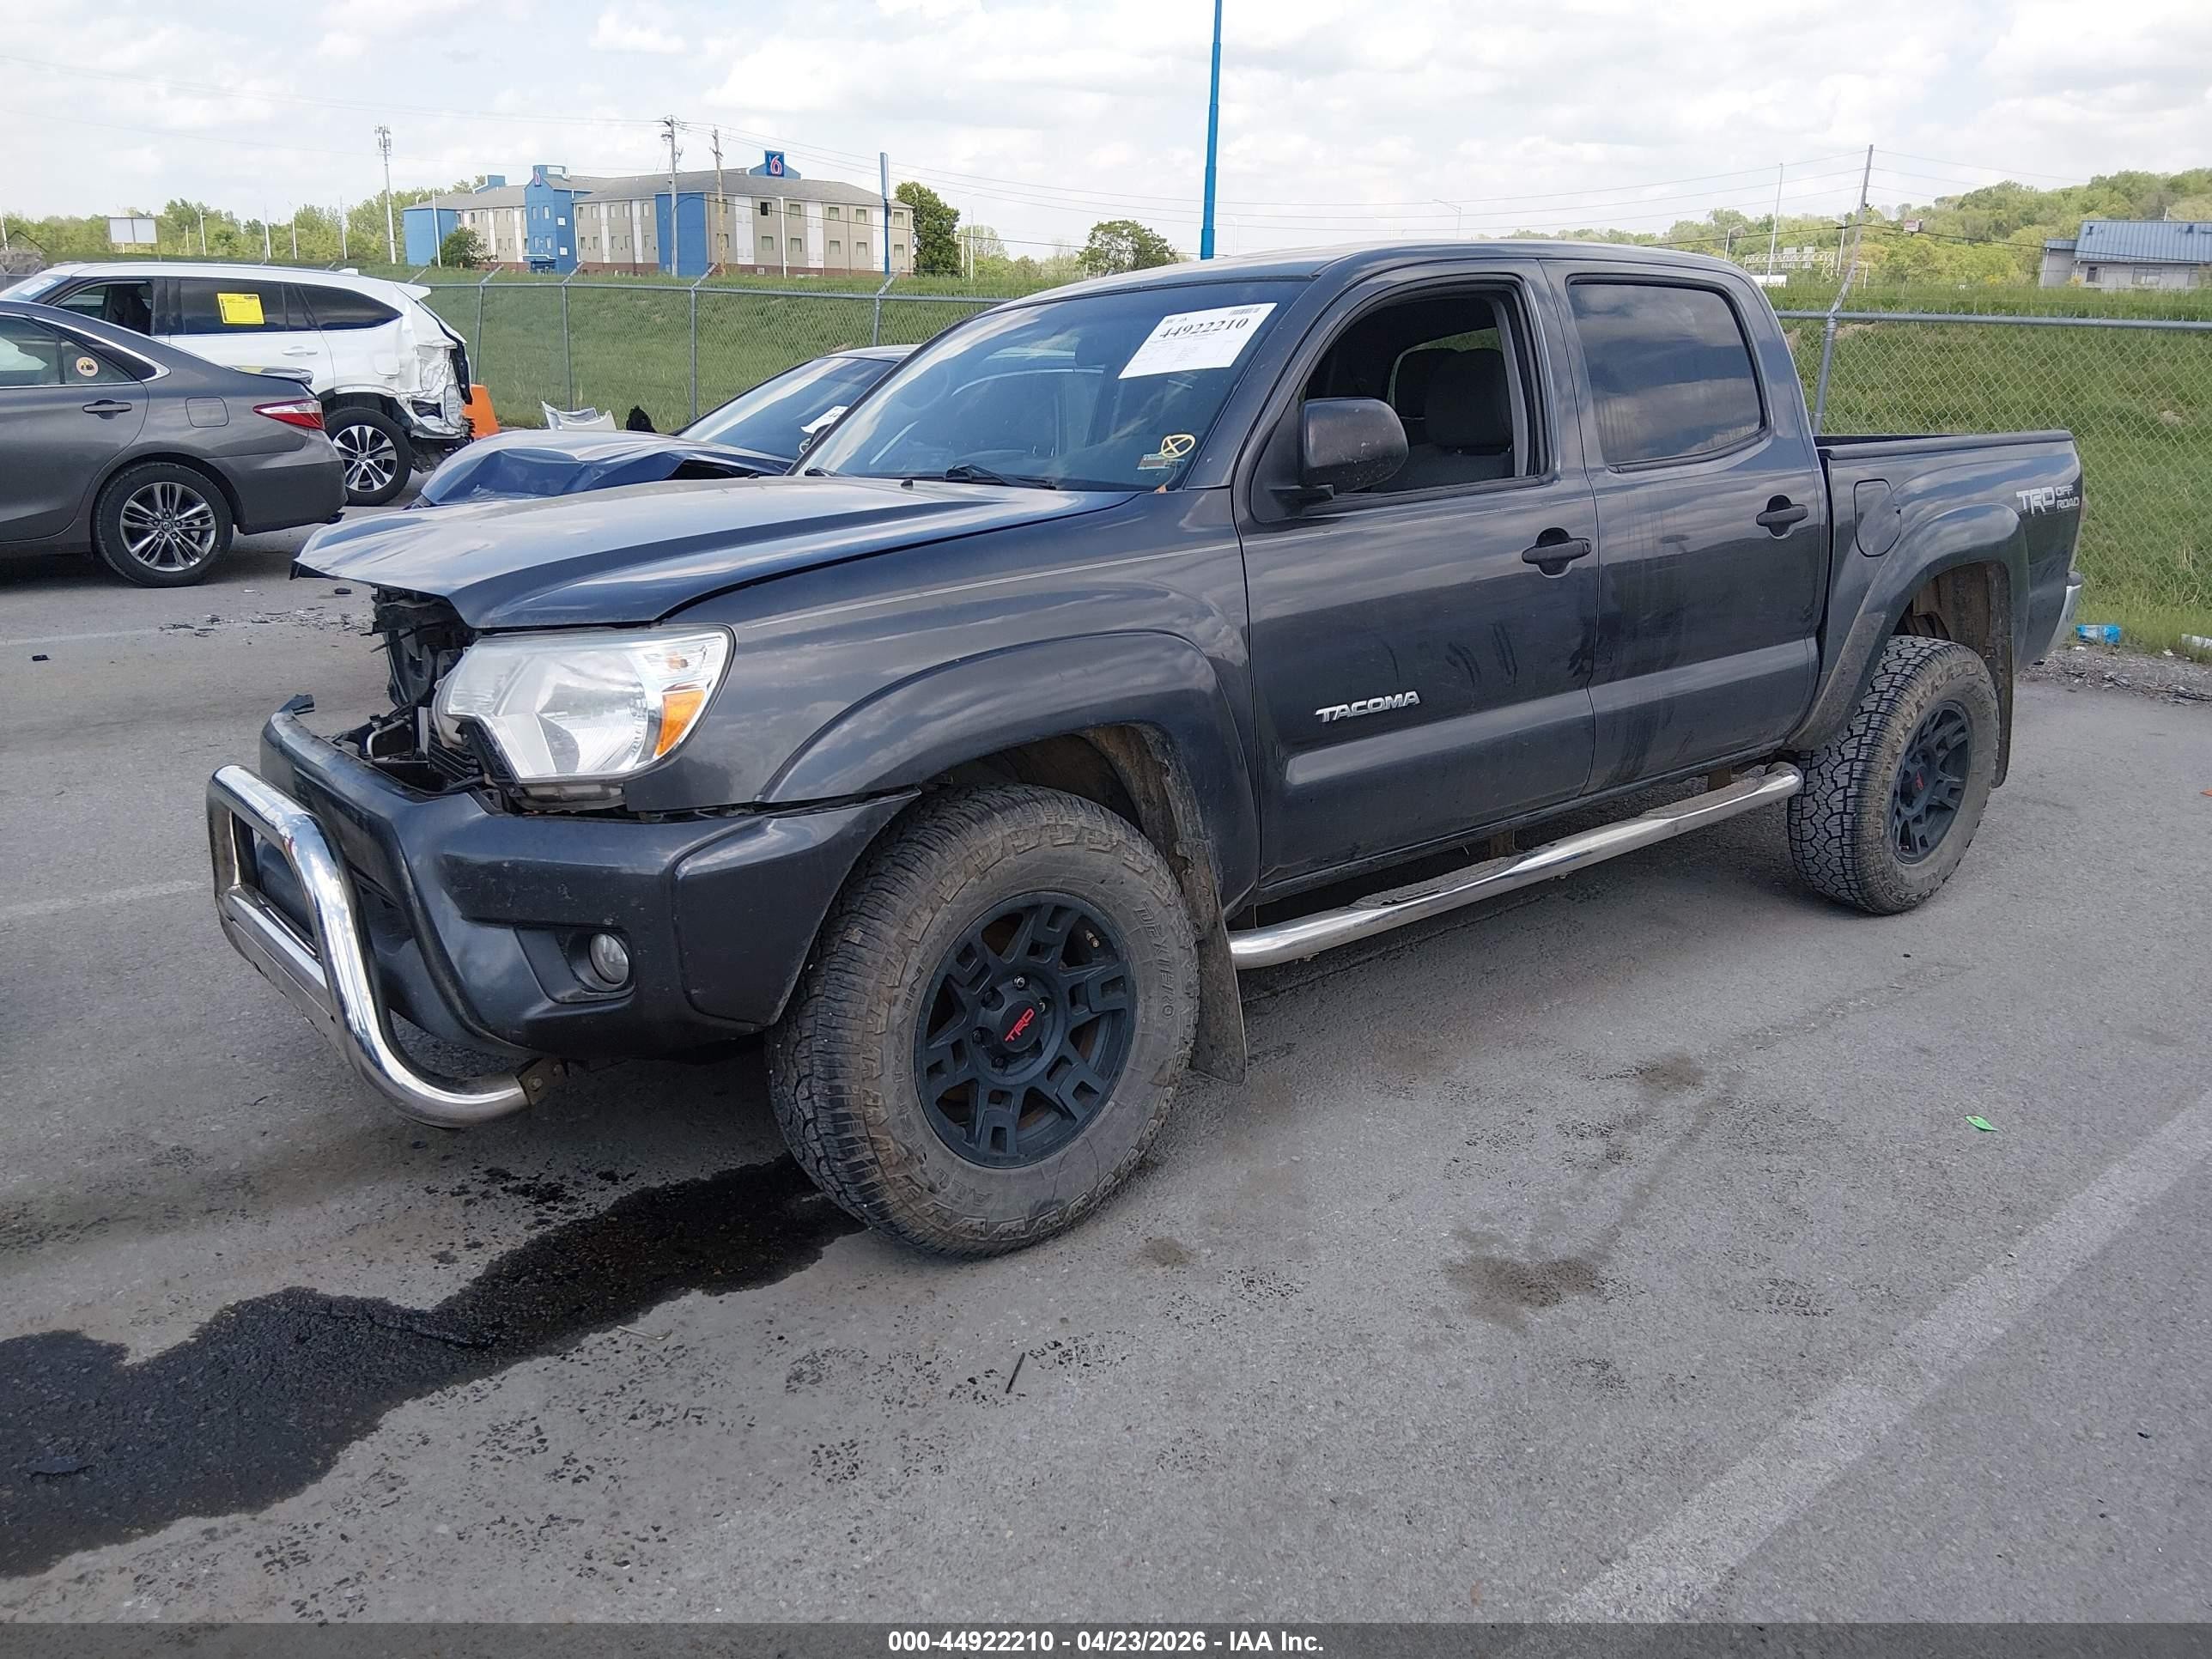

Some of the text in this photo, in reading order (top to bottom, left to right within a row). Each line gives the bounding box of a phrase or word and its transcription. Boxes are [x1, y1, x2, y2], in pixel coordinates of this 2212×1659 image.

[770, 155, 783, 175] 6
[1159, 318, 1249, 338] 44922210
[2016, 486, 2056, 515] TRD
[2057, 496, 2080, 510] ROAD
[1315, 690, 1421, 722] TACOMA
[1004, 1007, 1035, 1042] TRD
